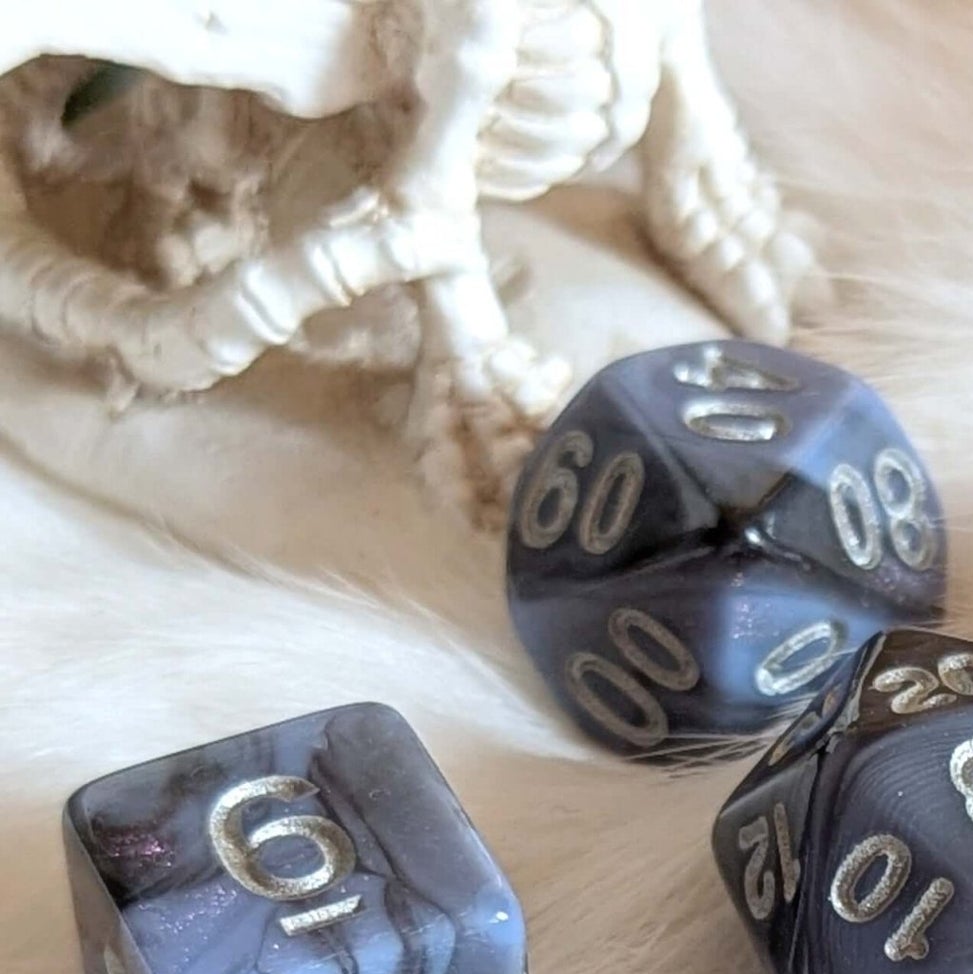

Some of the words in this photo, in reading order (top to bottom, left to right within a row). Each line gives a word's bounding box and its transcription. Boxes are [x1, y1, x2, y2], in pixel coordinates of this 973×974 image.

[518, 430, 644, 555] 60
[829, 447, 938, 571] 80
[565, 607, 699, 748] 00
[830, 834, 955, 962] 10
